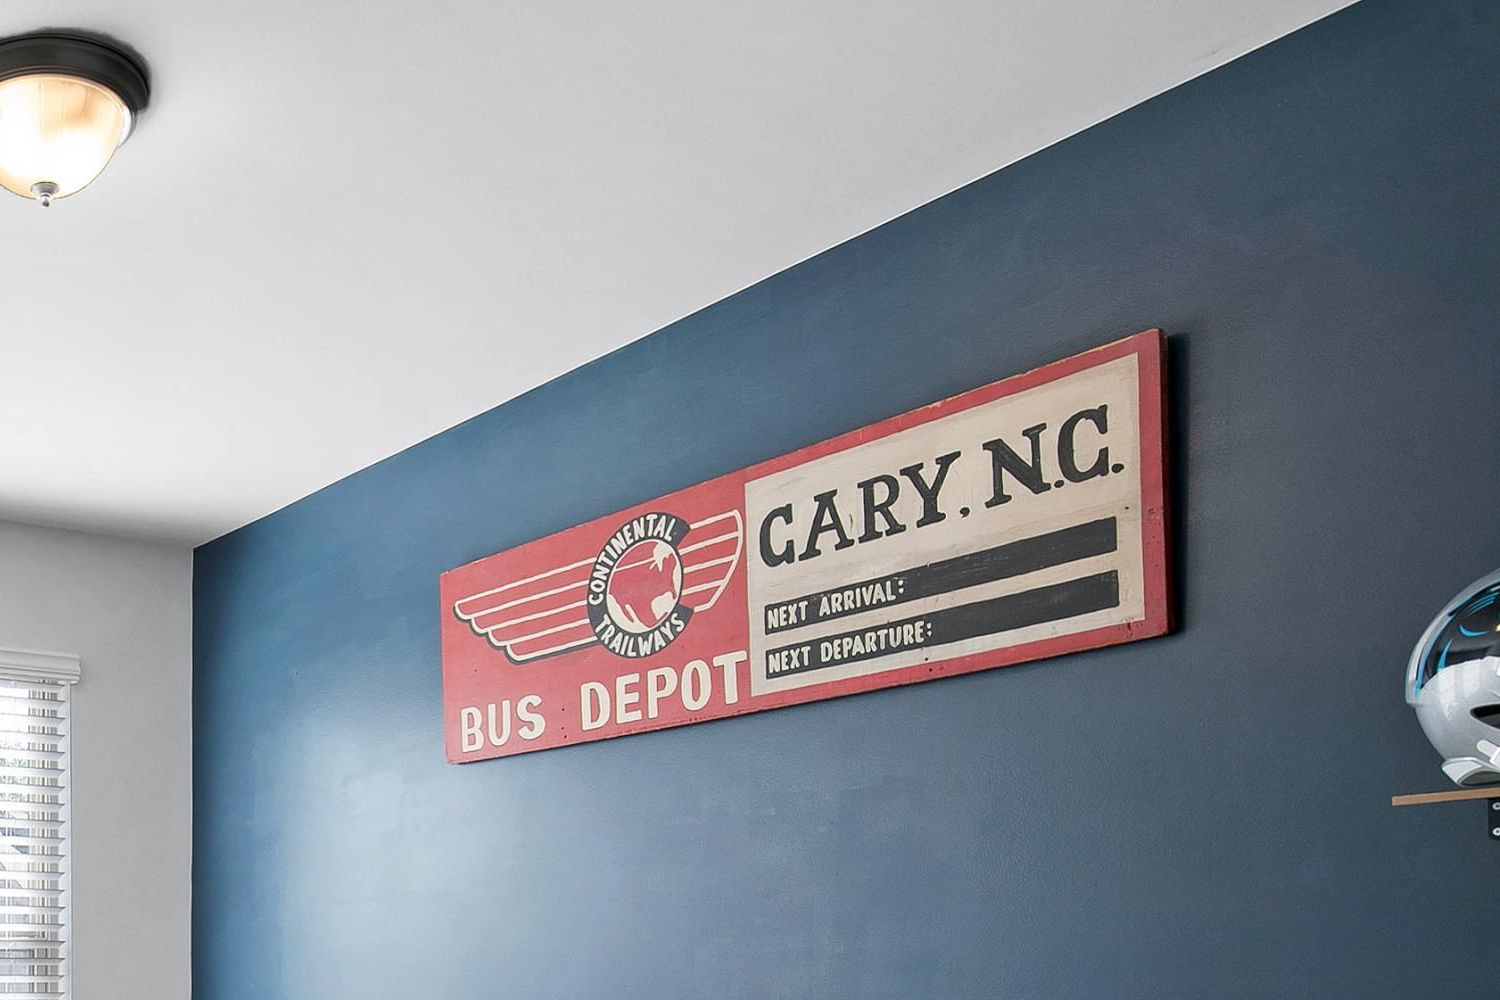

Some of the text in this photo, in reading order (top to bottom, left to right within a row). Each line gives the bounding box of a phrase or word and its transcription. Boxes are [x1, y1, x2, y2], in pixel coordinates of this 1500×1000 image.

[758, 404, 1125, 568] CARY, N.C.
[588, 513, 676, 606] CONTINENTAL
[595, 613, 685, 657] TRAILWAYS
[767, 580, 904, 629] NEXT ARRIVAL:
[768, 645, 811, 674] NEXT
[460, 650, 748, 753] BUS DEPOT
